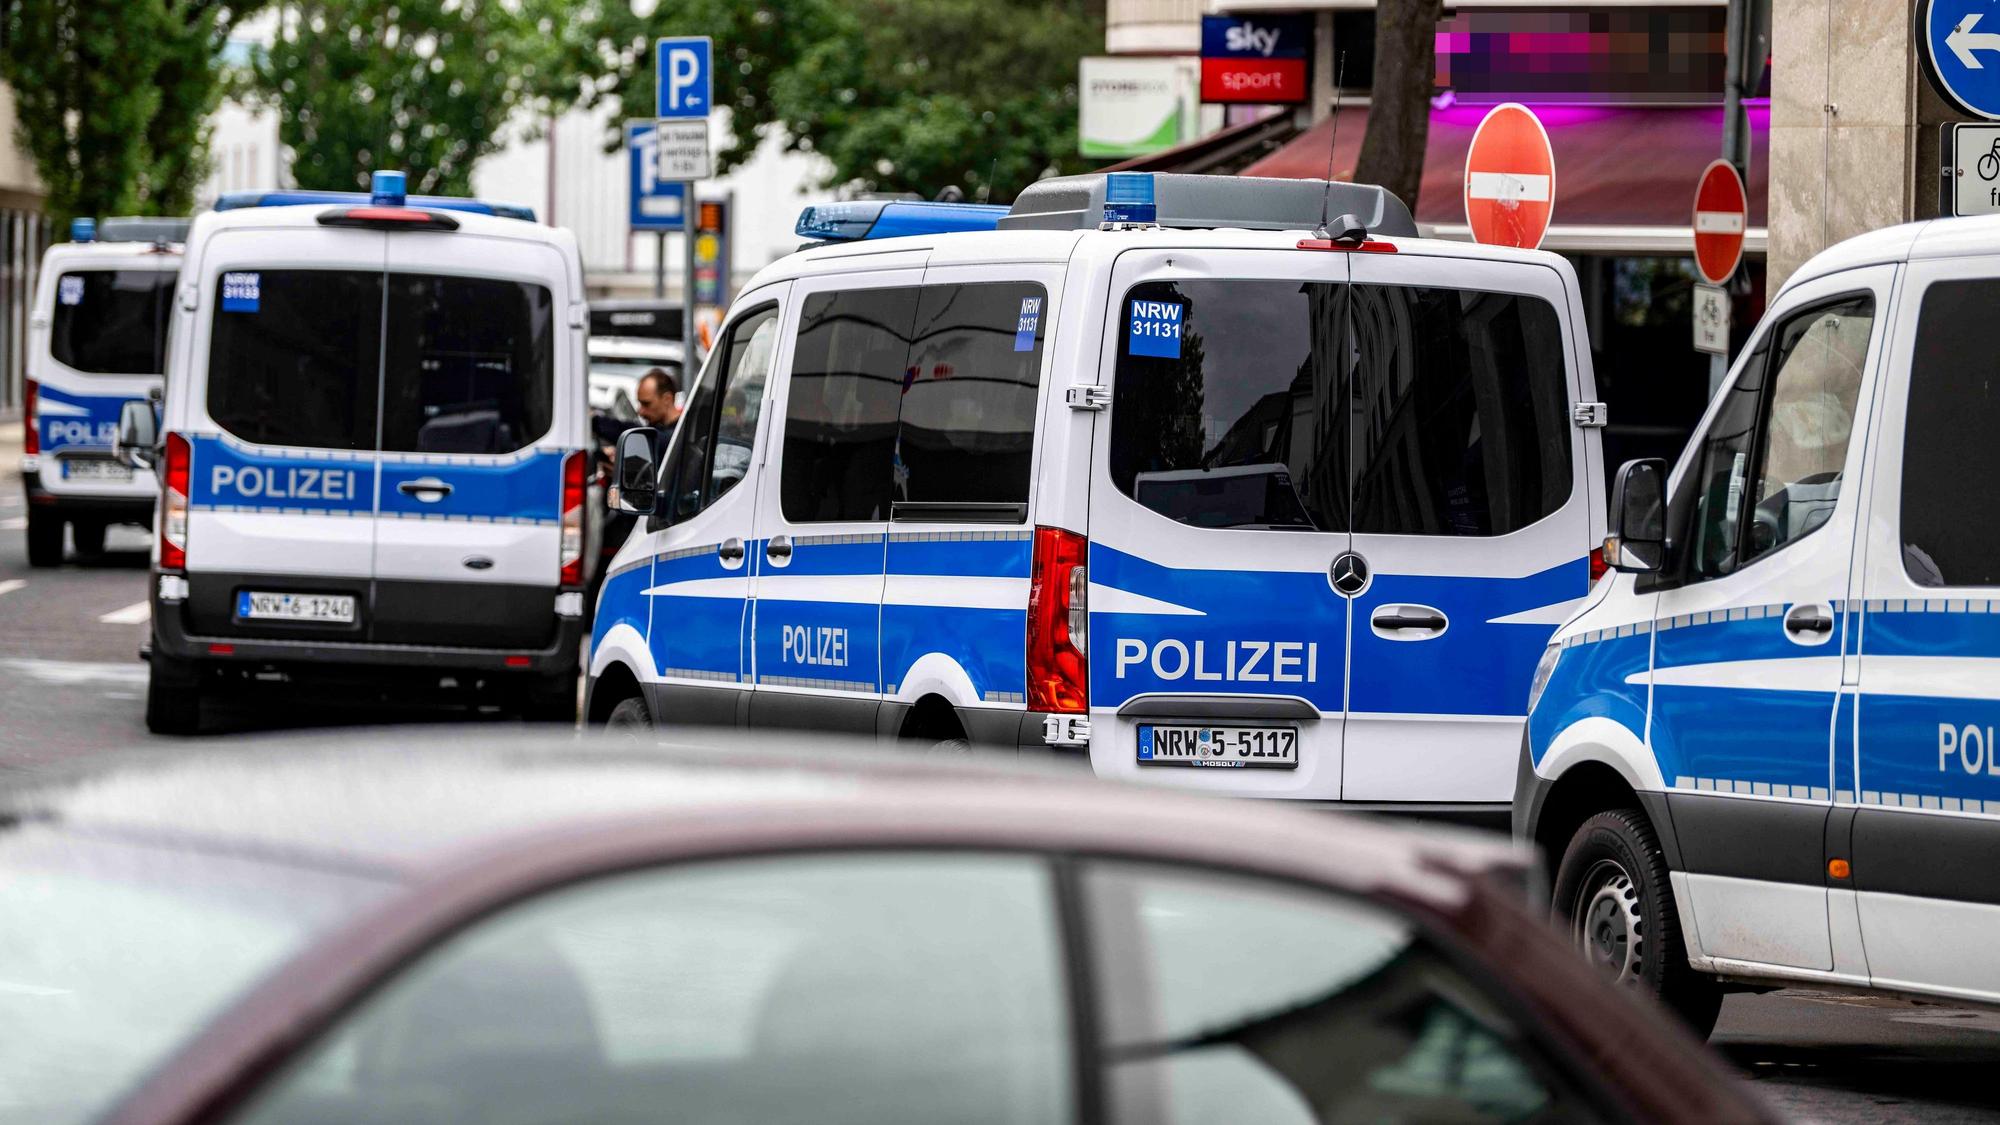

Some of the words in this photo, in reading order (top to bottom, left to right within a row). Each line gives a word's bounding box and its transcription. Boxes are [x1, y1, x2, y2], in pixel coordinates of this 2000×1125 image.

[1226, 21, 1280, 56] sky
[669, 49, 699, 110] P
[1222, 72, 1282, 90] sport
[1021, 299, 1040, 314] NRW
[1133, 302, 1179, 320] NRW
[1018, 318, 1038, 332] 31131
[1132, 321, 1179, 338] 31131
[48, 421, 117, 444] POLIZ
[211, 465, 355, 500] POLIZEI
[251, 596, 280, 613] NRW
[783, 625, 848, 667] POLIZEI
[1116, 638, 1317, 682] POLIZEI
[1154, 730, 1197, 756] NRW
[1212, 731, 1294, 758] 5-5117
